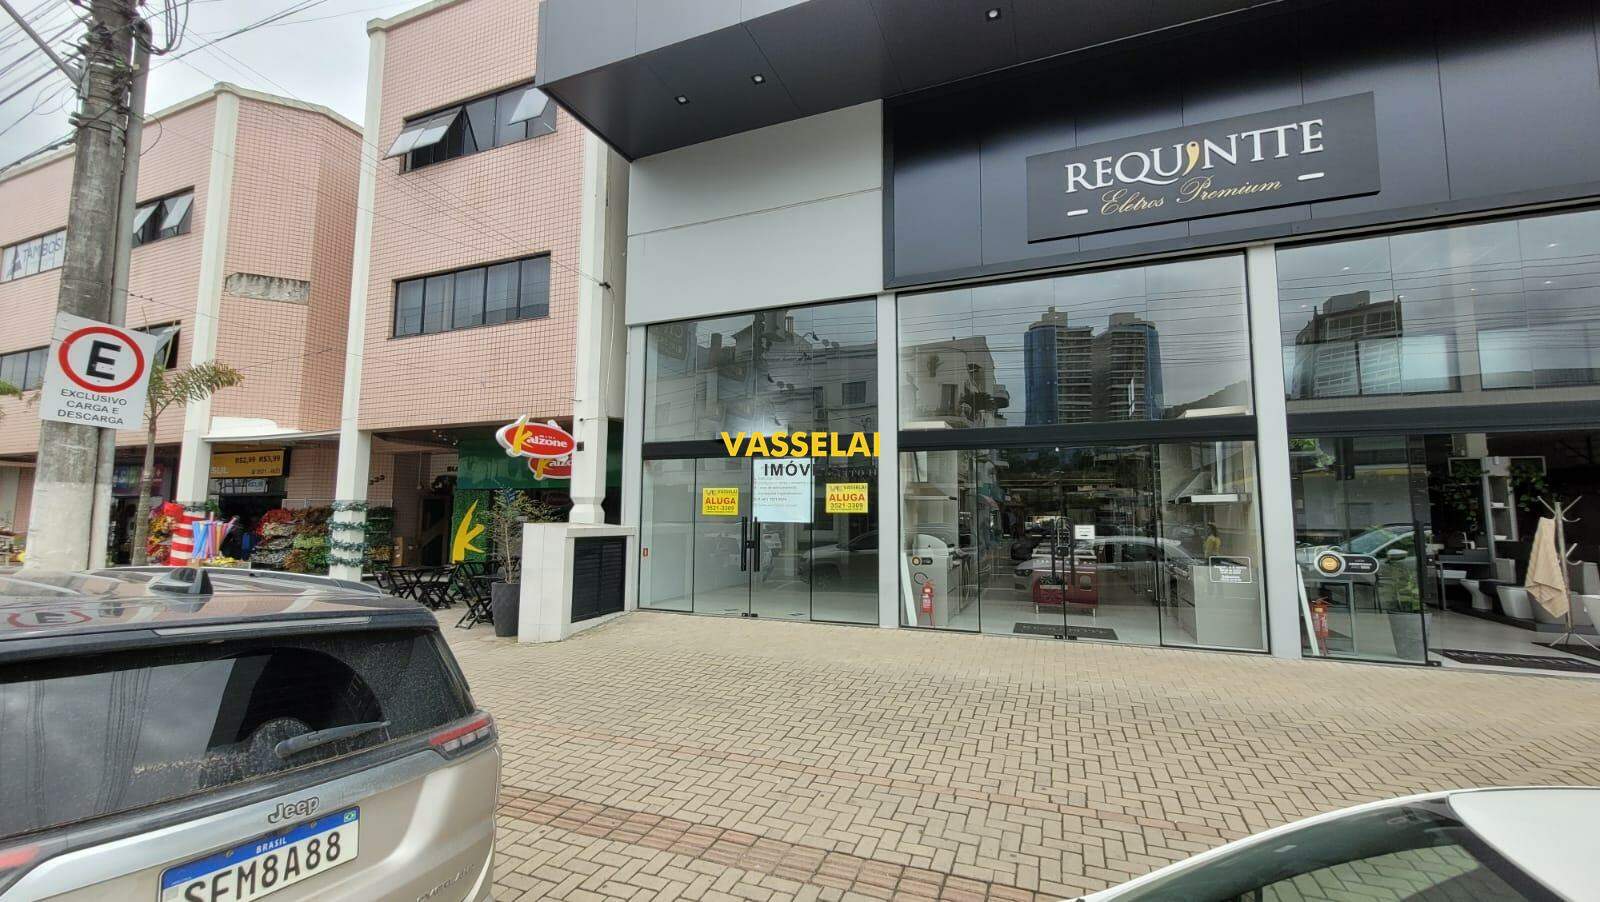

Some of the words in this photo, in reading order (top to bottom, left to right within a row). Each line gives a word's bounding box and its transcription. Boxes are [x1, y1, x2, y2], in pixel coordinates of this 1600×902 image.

[1176, 174, 1283, 204] Premium
[86, 340, 122, 380] E
[61, 388, 127, 406] EXCLUSIVO
[66, 400, 109, 413] CARGA
[57, 409, 124, 425] DESCARGA
[704, 497, 736, 505] ALUGA
[829, 493, 865, 502] ALUGA
[268, 796, 320, 824] Jeep
[255, 836, 288, 855] BRASIL
